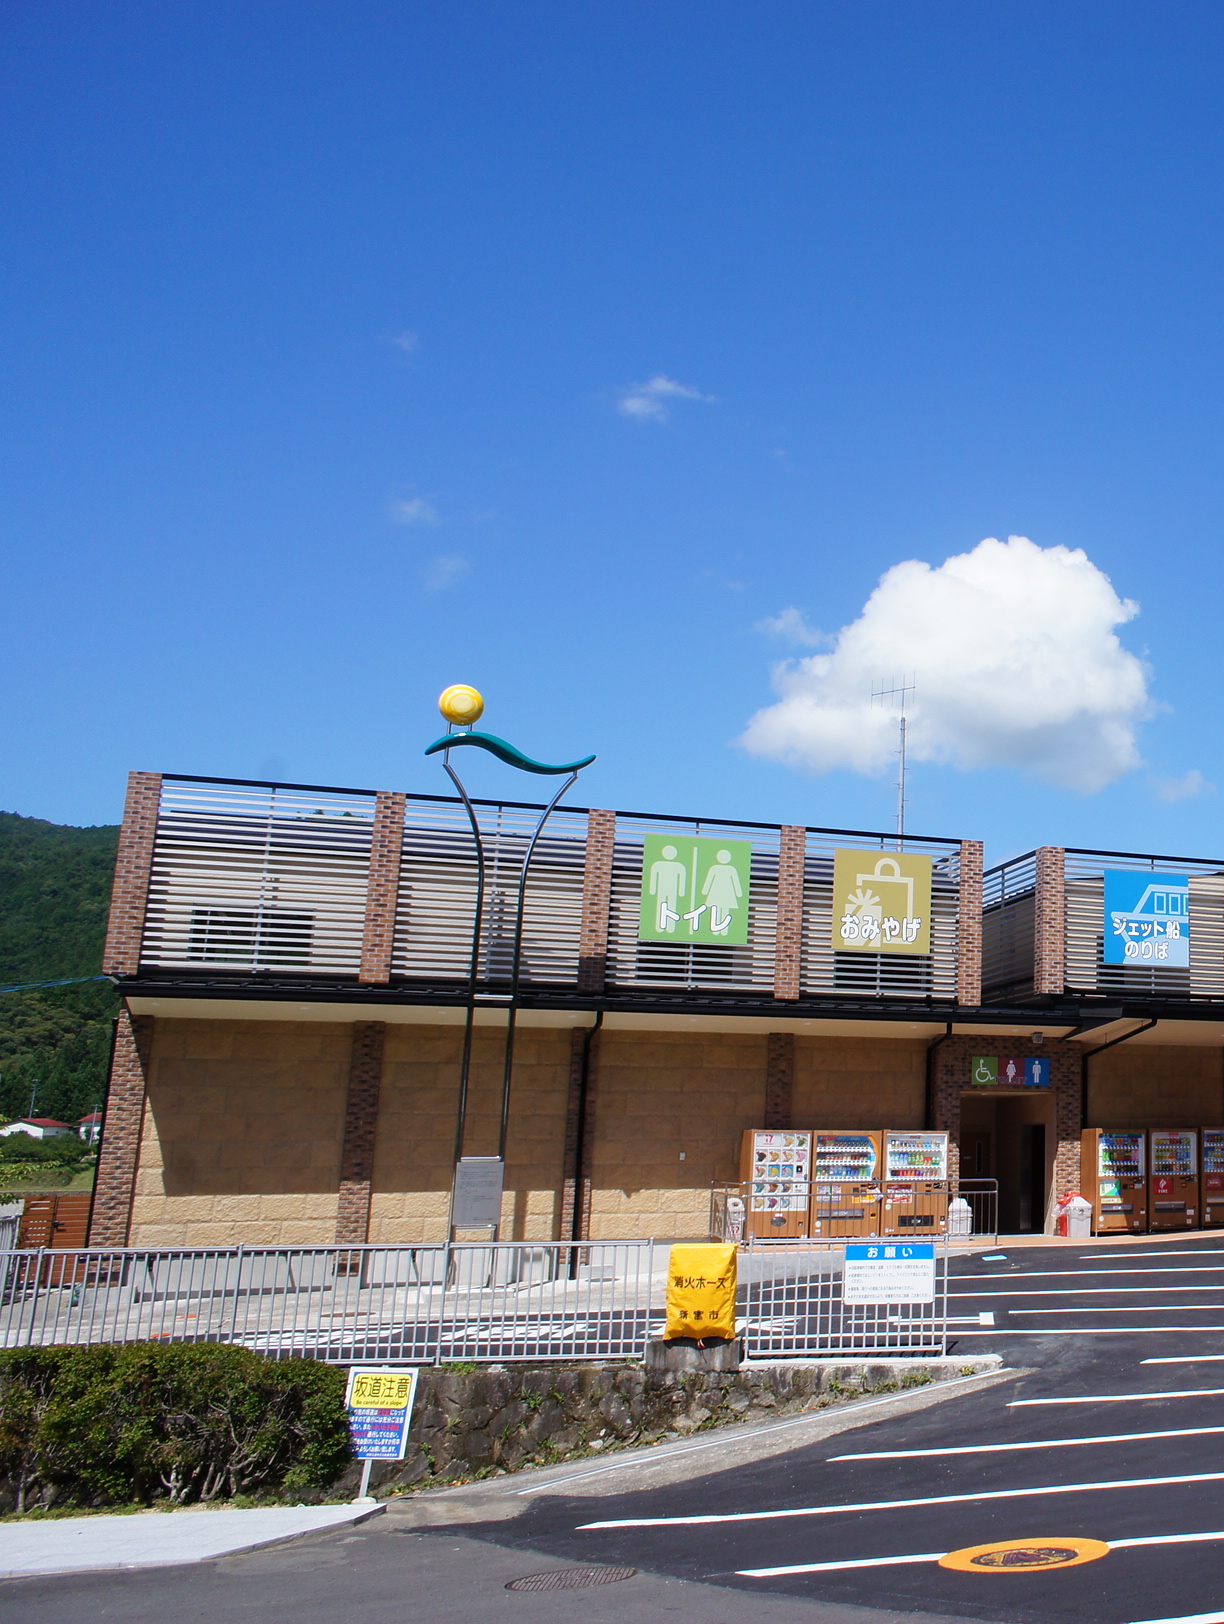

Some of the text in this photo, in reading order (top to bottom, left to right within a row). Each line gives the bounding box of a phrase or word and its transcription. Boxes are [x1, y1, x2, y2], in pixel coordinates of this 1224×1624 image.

[659, 902, 732, 932] トイレ
[840, 913, 922, 942] おみやげ
[1112, 917, 1181, 940] ジェット船
[1124, 940, 1169, 960] のりば
[867, 1246, 913, 1258] お願い
[674, 1276, 726, 1289] 消火ホース
[355, 1376, 410, 1398] 坂道注意
